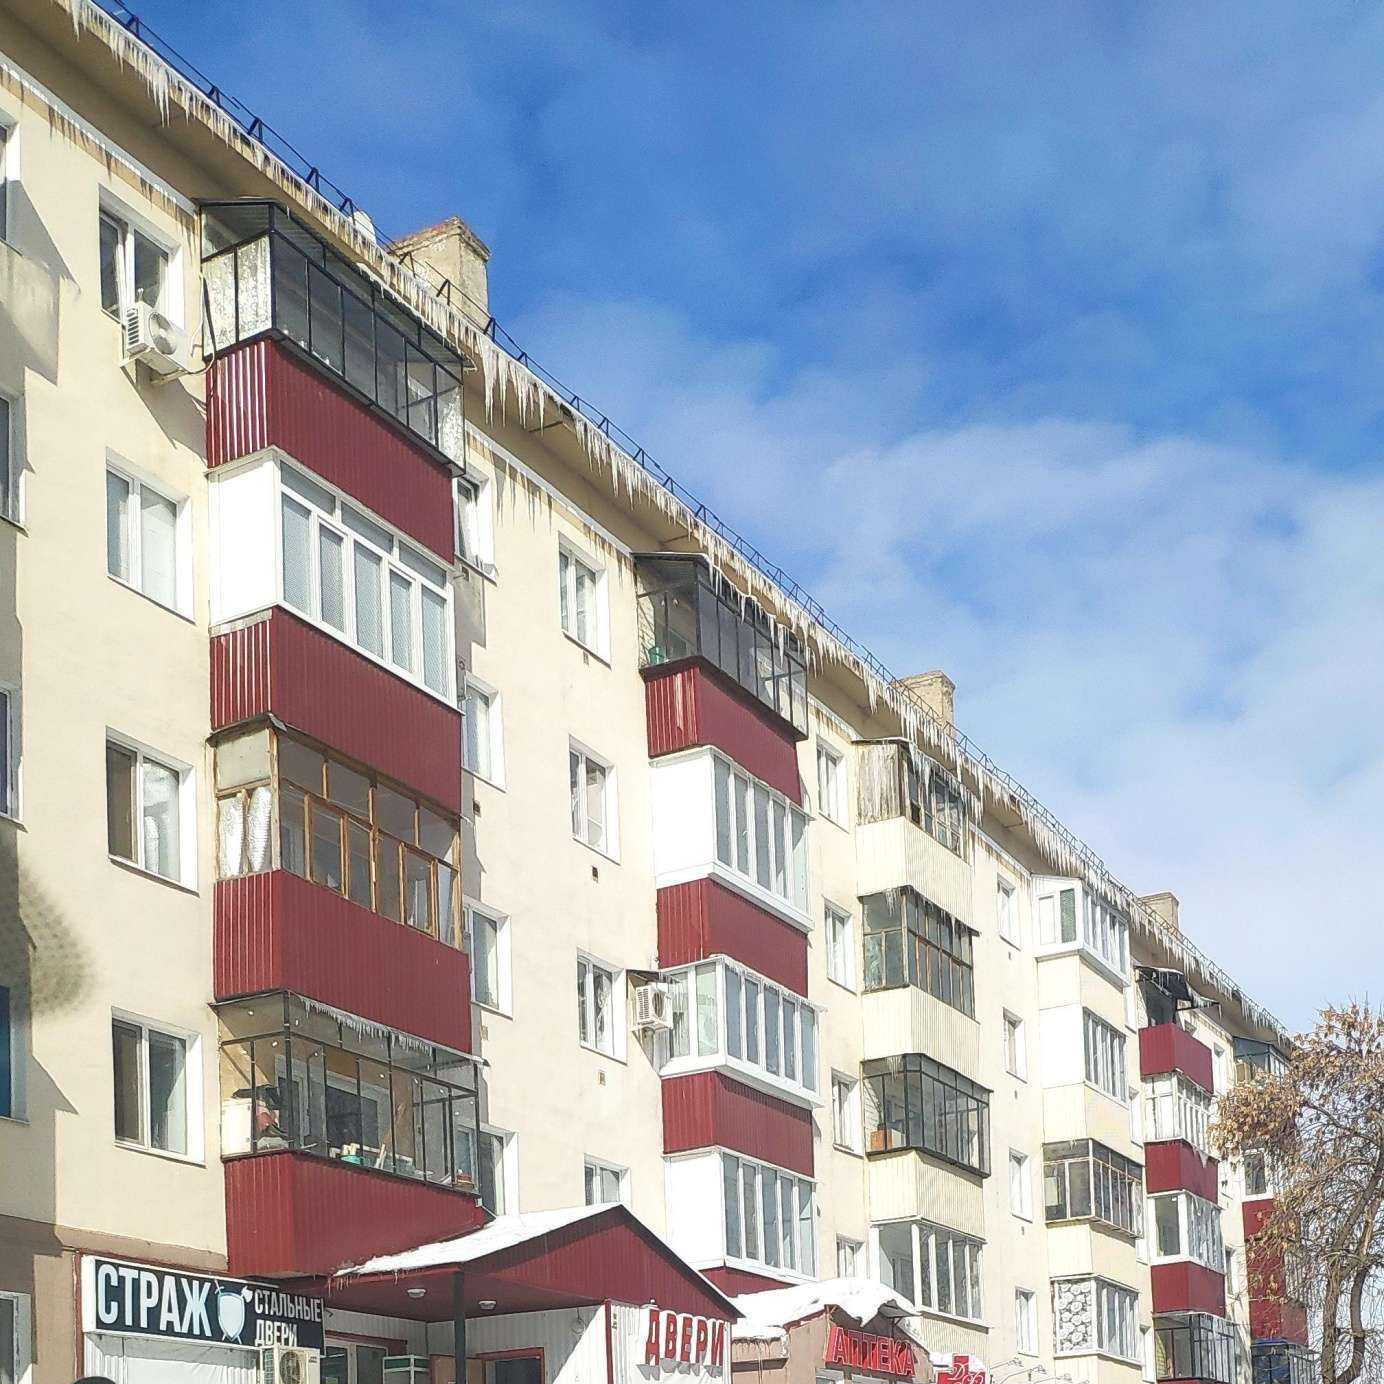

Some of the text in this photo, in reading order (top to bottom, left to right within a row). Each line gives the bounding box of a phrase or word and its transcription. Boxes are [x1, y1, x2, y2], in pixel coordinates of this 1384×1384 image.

[98, 1263, 212, 1337] СТРАЖ
[254, 1289, 322, 1323] СТАЛЬНЫЕ
[255, 1320, 298, 1347] ДВЕРИ
[645, 1308, 724, 1366] ДВЕРИ
[826, 1326, 915, 1376] АПТЕКА
